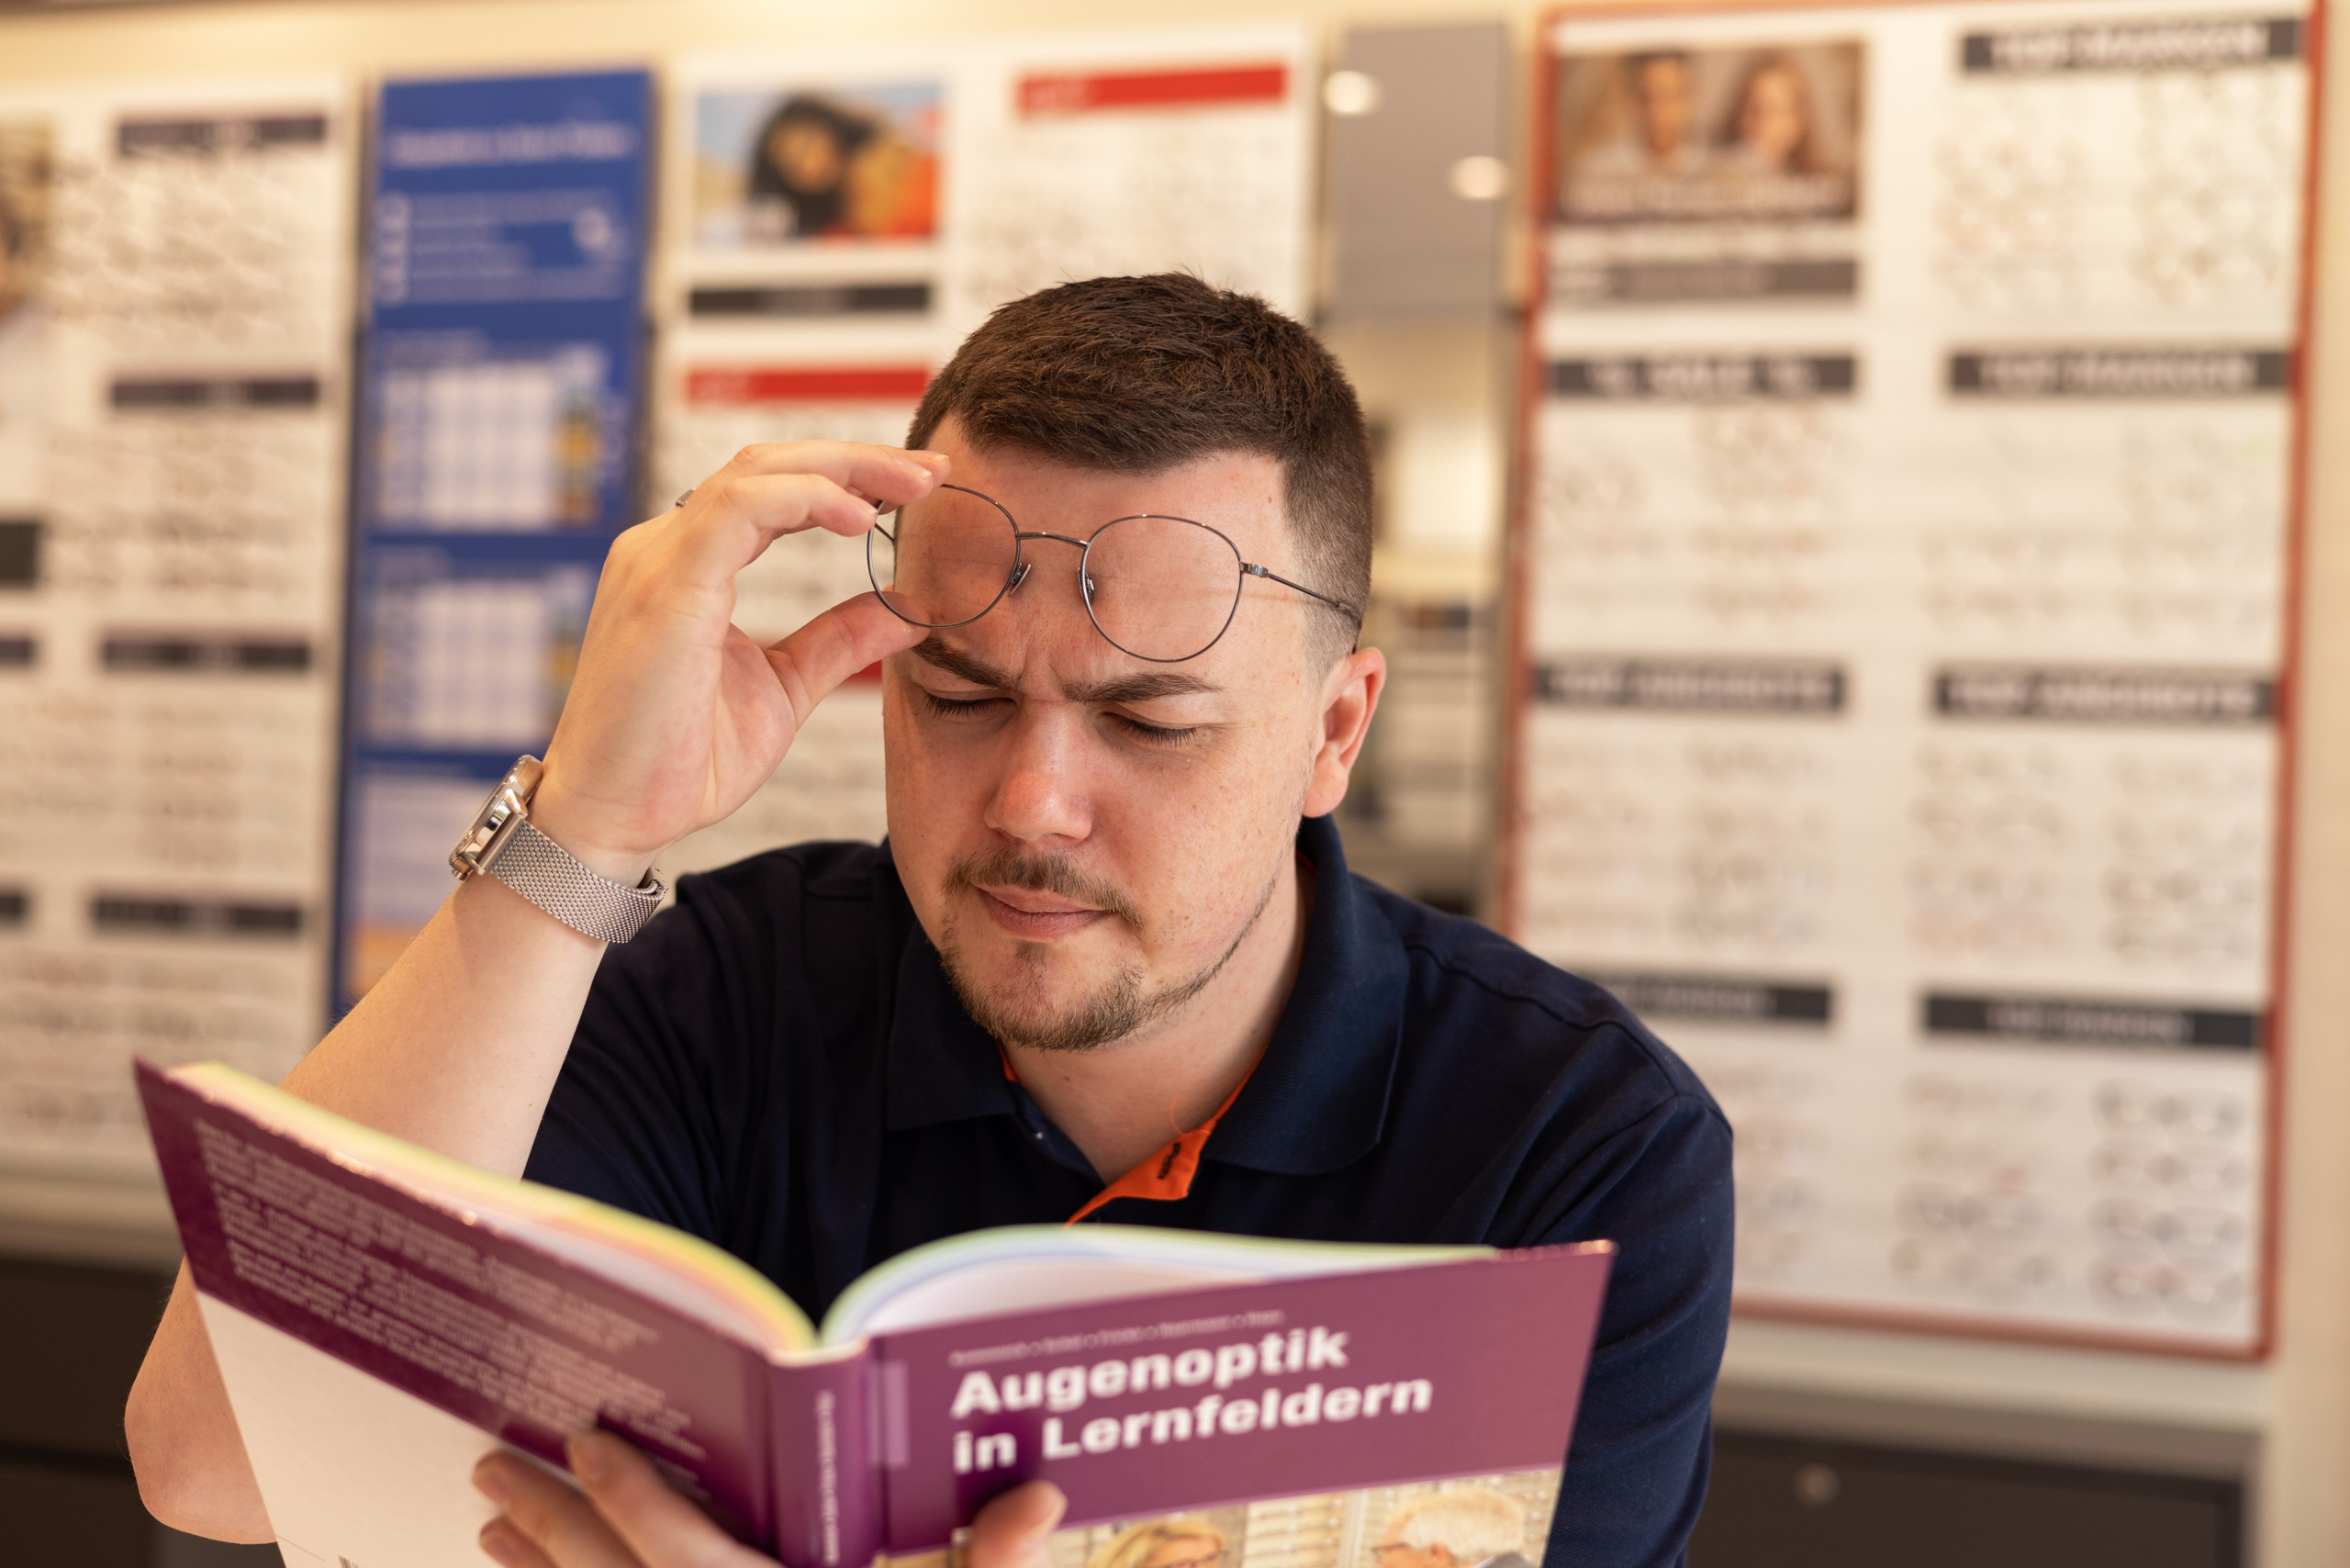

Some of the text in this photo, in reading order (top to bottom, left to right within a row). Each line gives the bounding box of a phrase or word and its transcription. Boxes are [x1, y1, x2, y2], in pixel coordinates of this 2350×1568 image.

[951, 1326, 1349, 1417] Augenoptik
[953, 1379, 1433, 1474] in Lernfeldern
